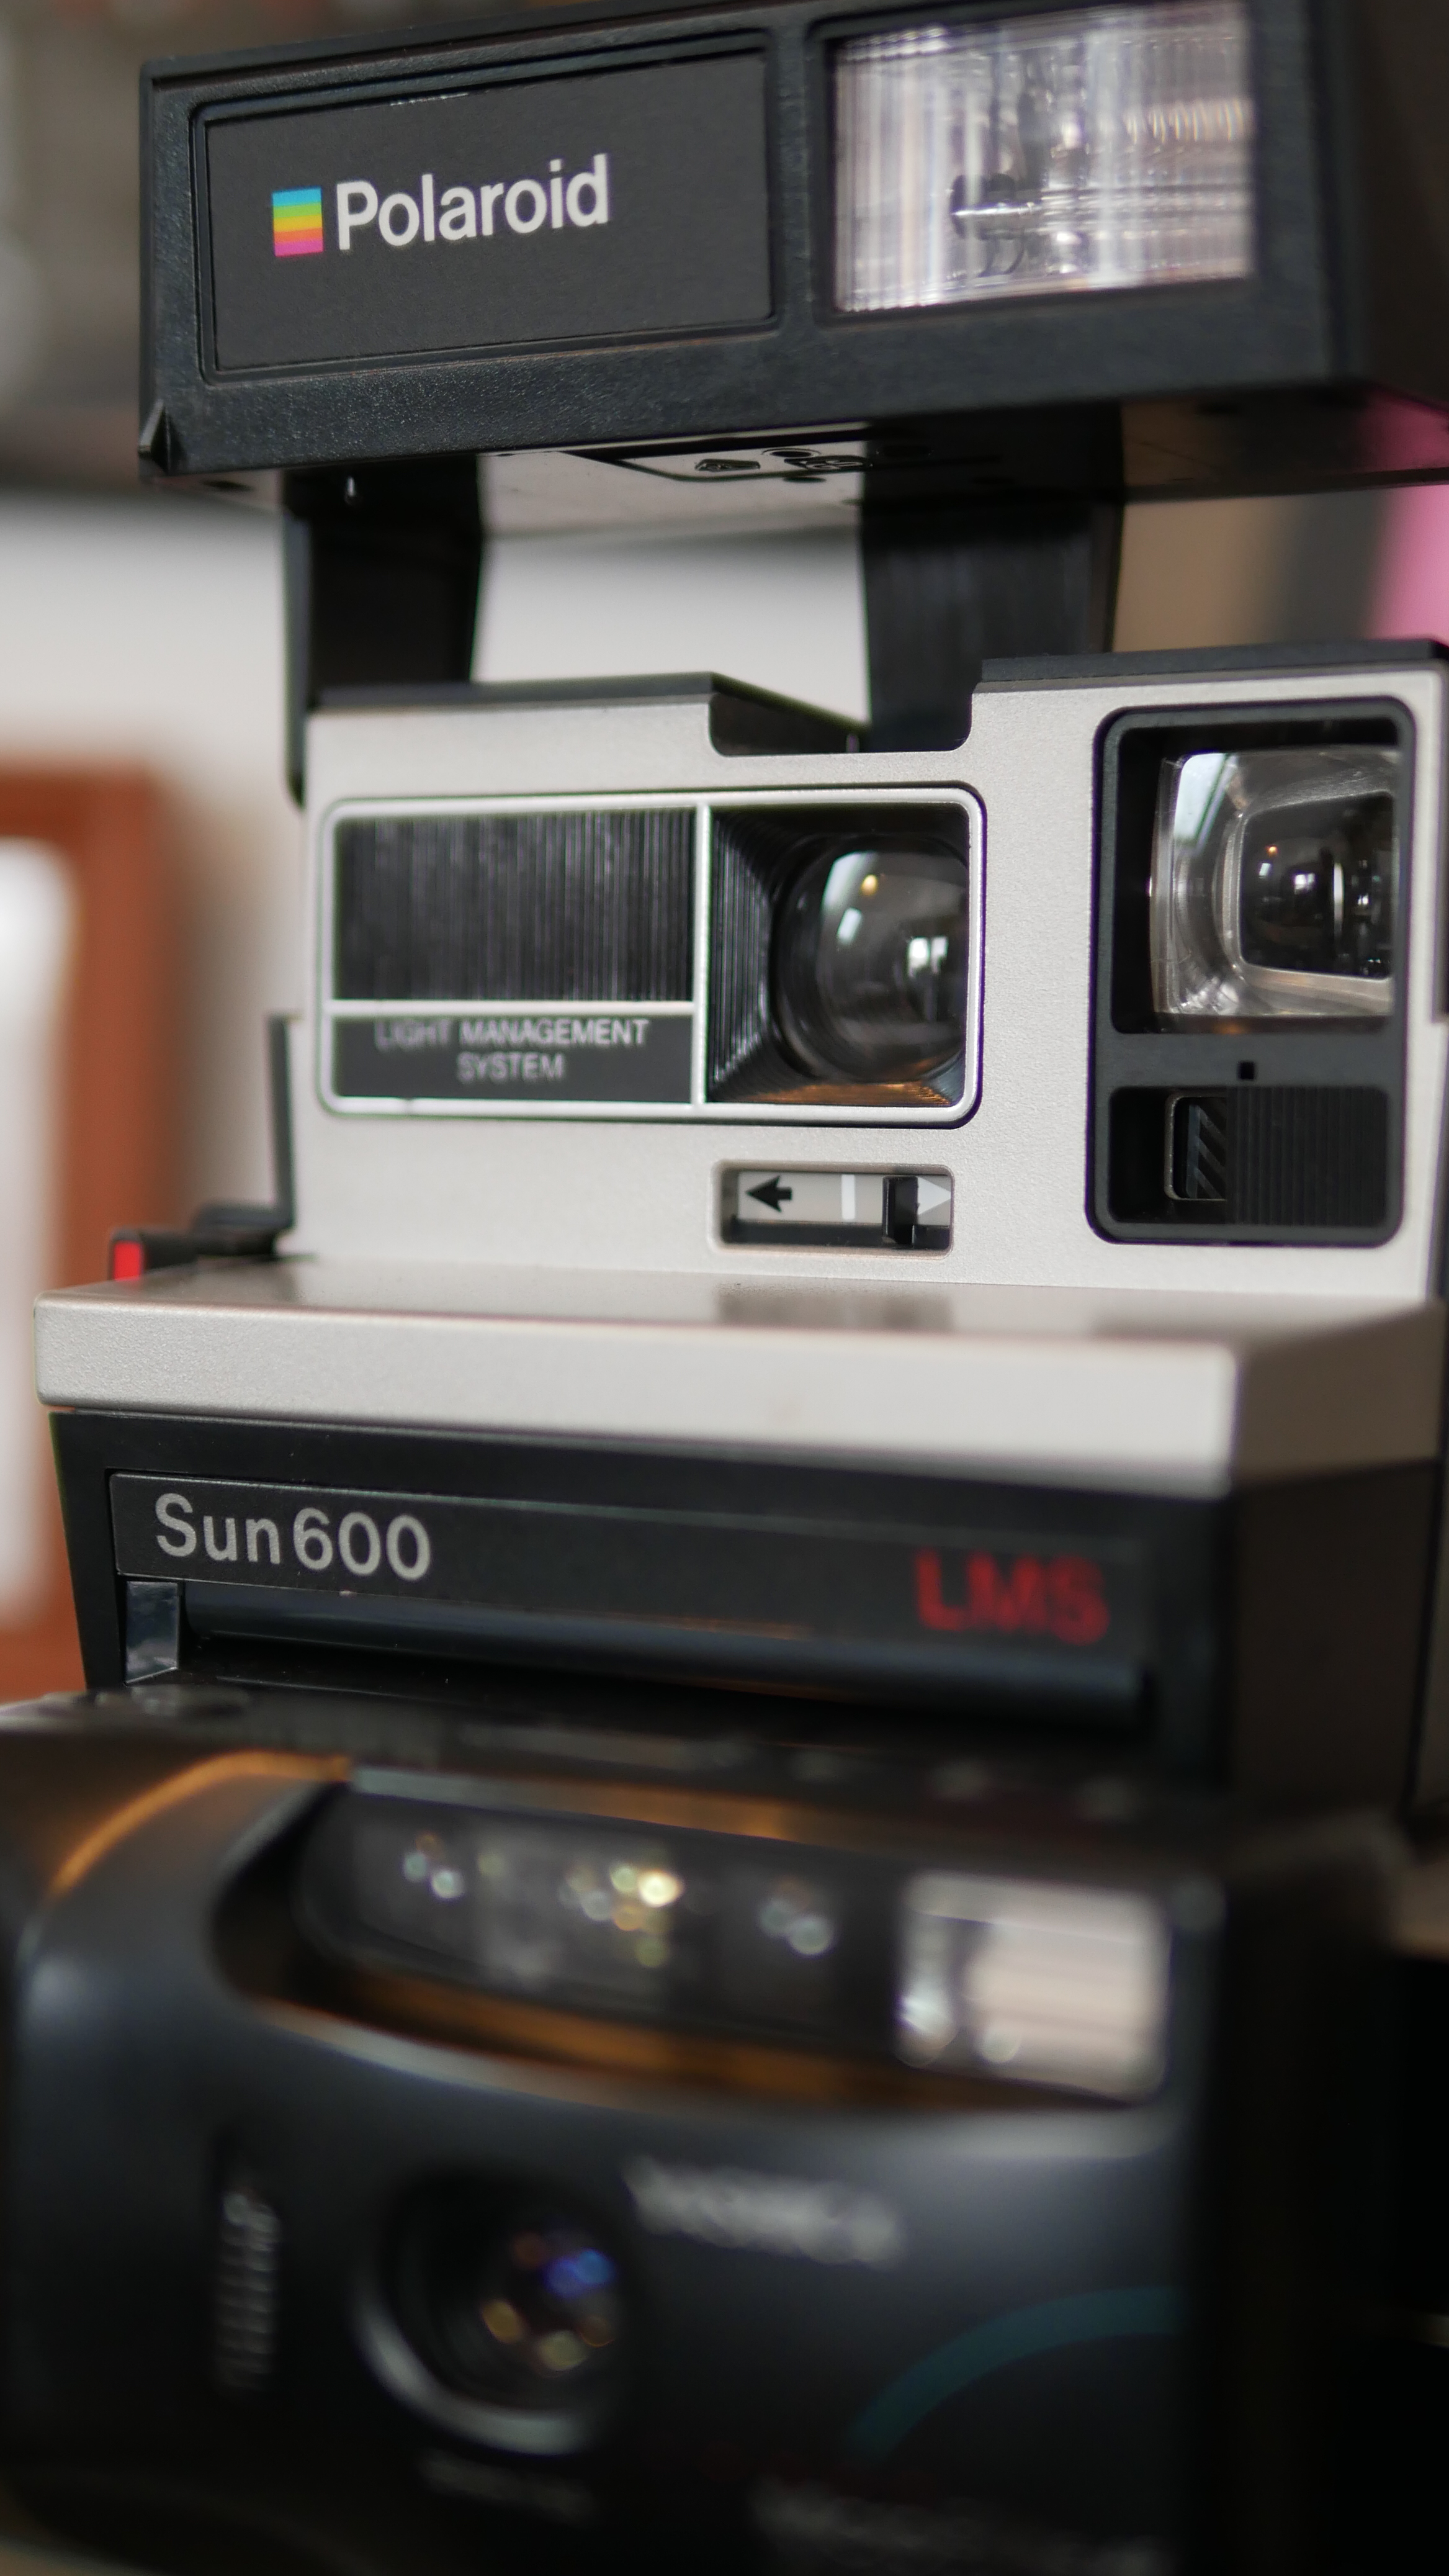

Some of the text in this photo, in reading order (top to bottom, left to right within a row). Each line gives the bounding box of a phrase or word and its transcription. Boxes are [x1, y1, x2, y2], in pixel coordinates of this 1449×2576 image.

[336, 153, 609, 251] Polaroid
[375, 1018, 649, 1049] LIGHT MANAGEMENT
[457, 1052, 565, 1082] SYSTEM
[915, 1549, 1110, 1646] LMS
